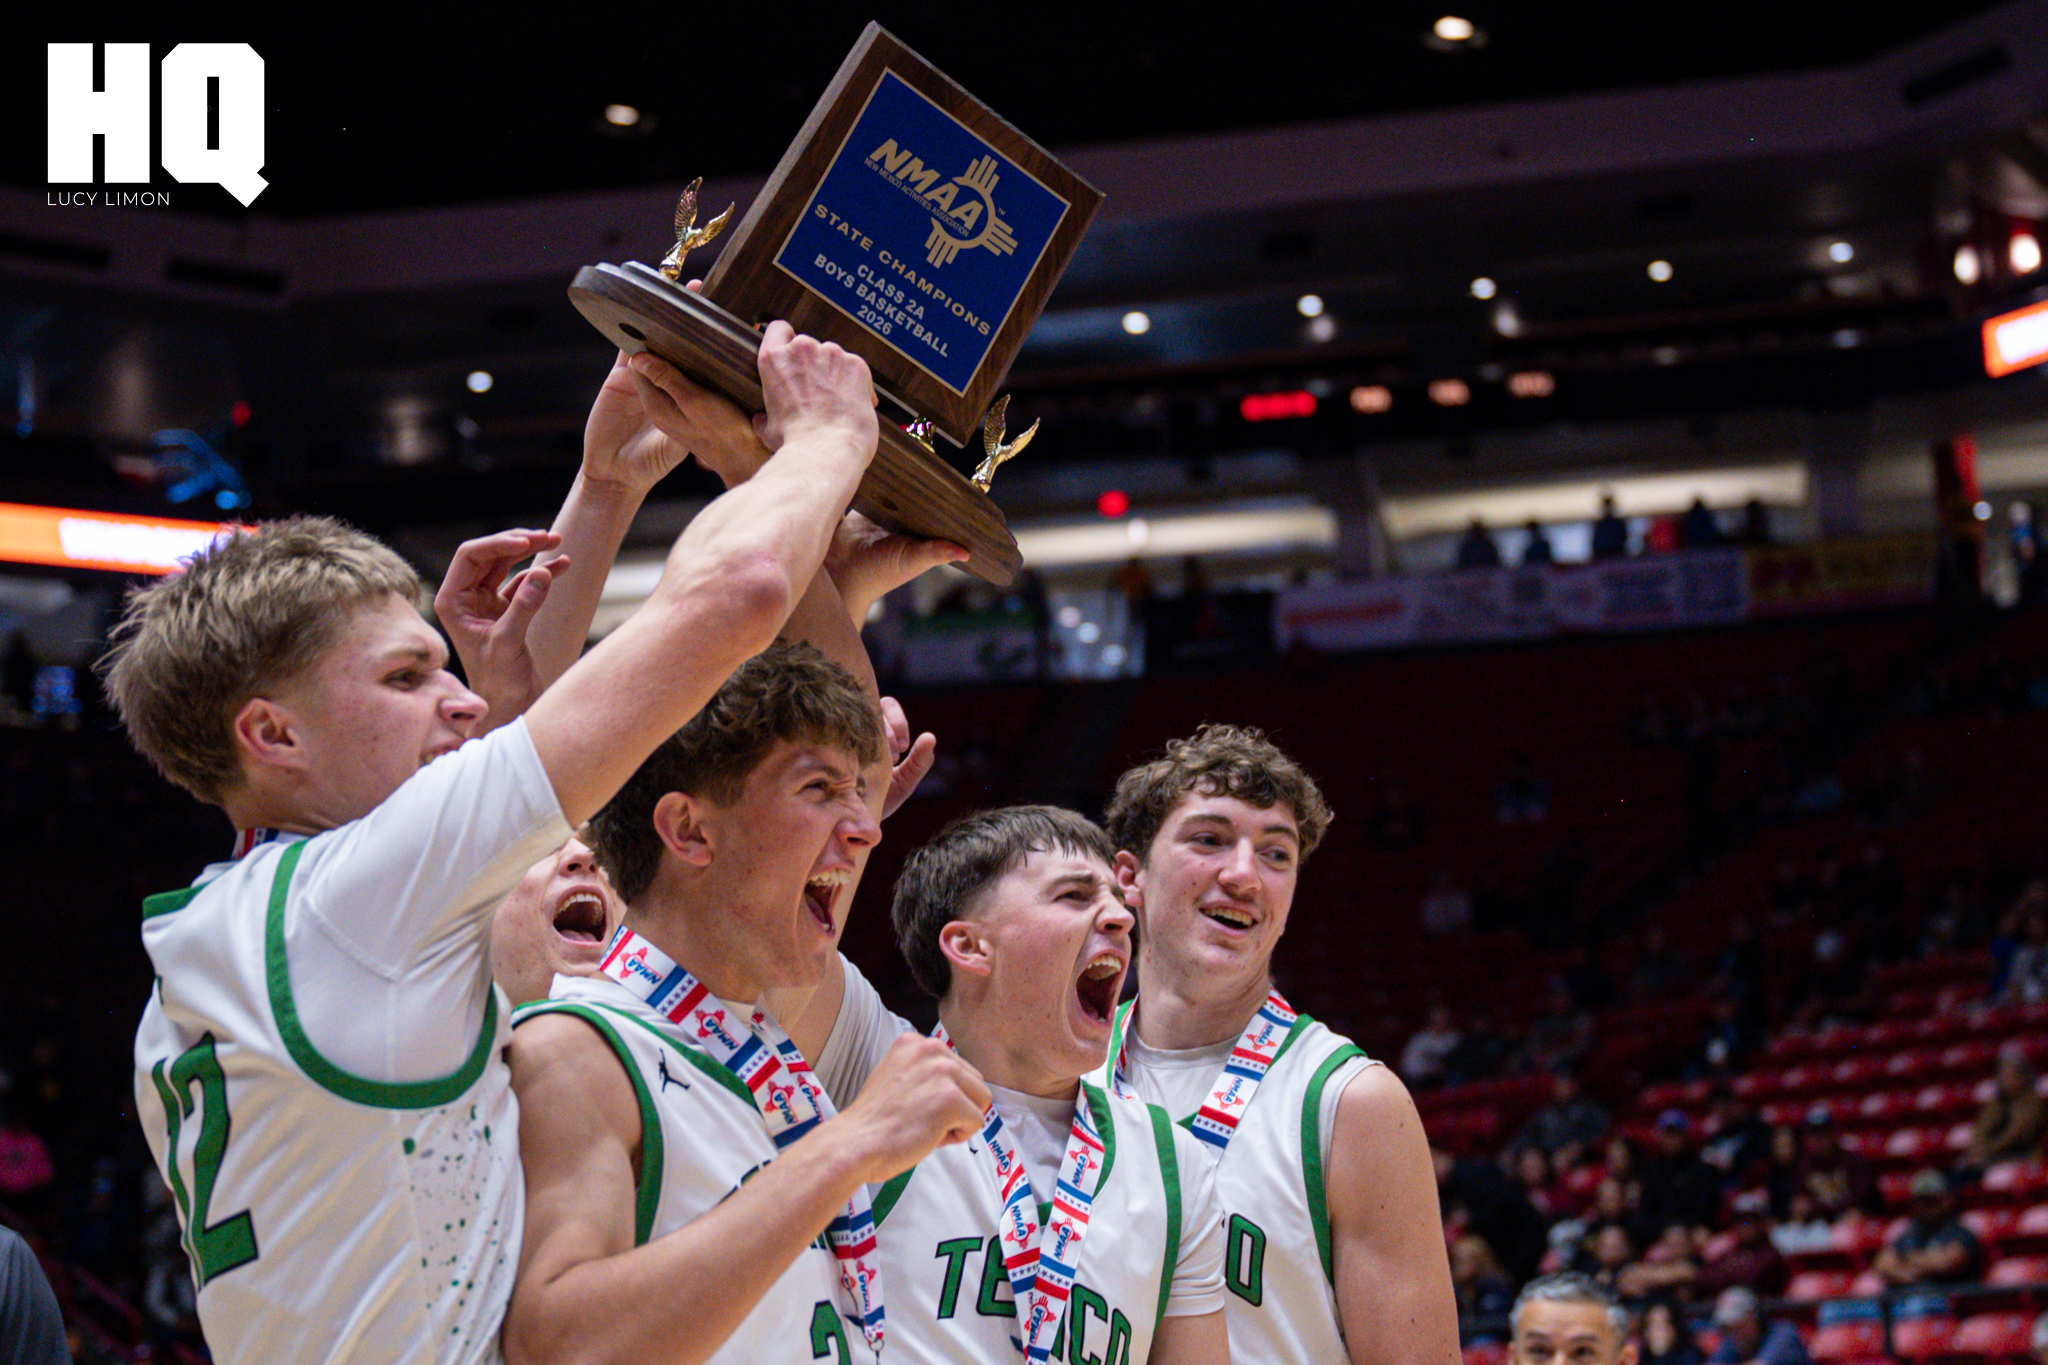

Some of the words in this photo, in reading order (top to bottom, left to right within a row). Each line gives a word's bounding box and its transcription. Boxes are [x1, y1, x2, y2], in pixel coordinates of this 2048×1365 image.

[863, 157, 879, 173] NEW
[878, 167, 903, 190] MEXICO
[901, 183, 932, 211] ACTIVITIES
[931, 206, 971, 238] ASSOCIATION
[869, 138, 984, 231] NMAA
[814, 203, 874, 252] STATE
[878, 249, 991, 336] CHAMPIONS
[813, 252, 856, 289] BOYS
[855, 282, 949, 358] BASKETBALL
[857, 264, 905, 304] CLASS
[905, 298, 925, 320] 2A
[856, 304, 894, 336] 2026
[627, 957, 662, 985] NMAA
[704, 1017, 739, 1051] NMAA
[1258, 1022, 1275, 1044] NMAA
[1224, 1076, 1243, 1103] NMAA
[774, 1091, 797, 1125] NMAA
[990, 1140, 1009, 1172] NMAA
[1072, 1155, 1087, 1186] NMAA
[1010, 1205, 1026, 1237] NMAA
[1054, 1226, 1071, 1260] NMAA
[935, 1235, 1132, 1365] TECO
[1029, 1307, 1044, 1344] NMAA
